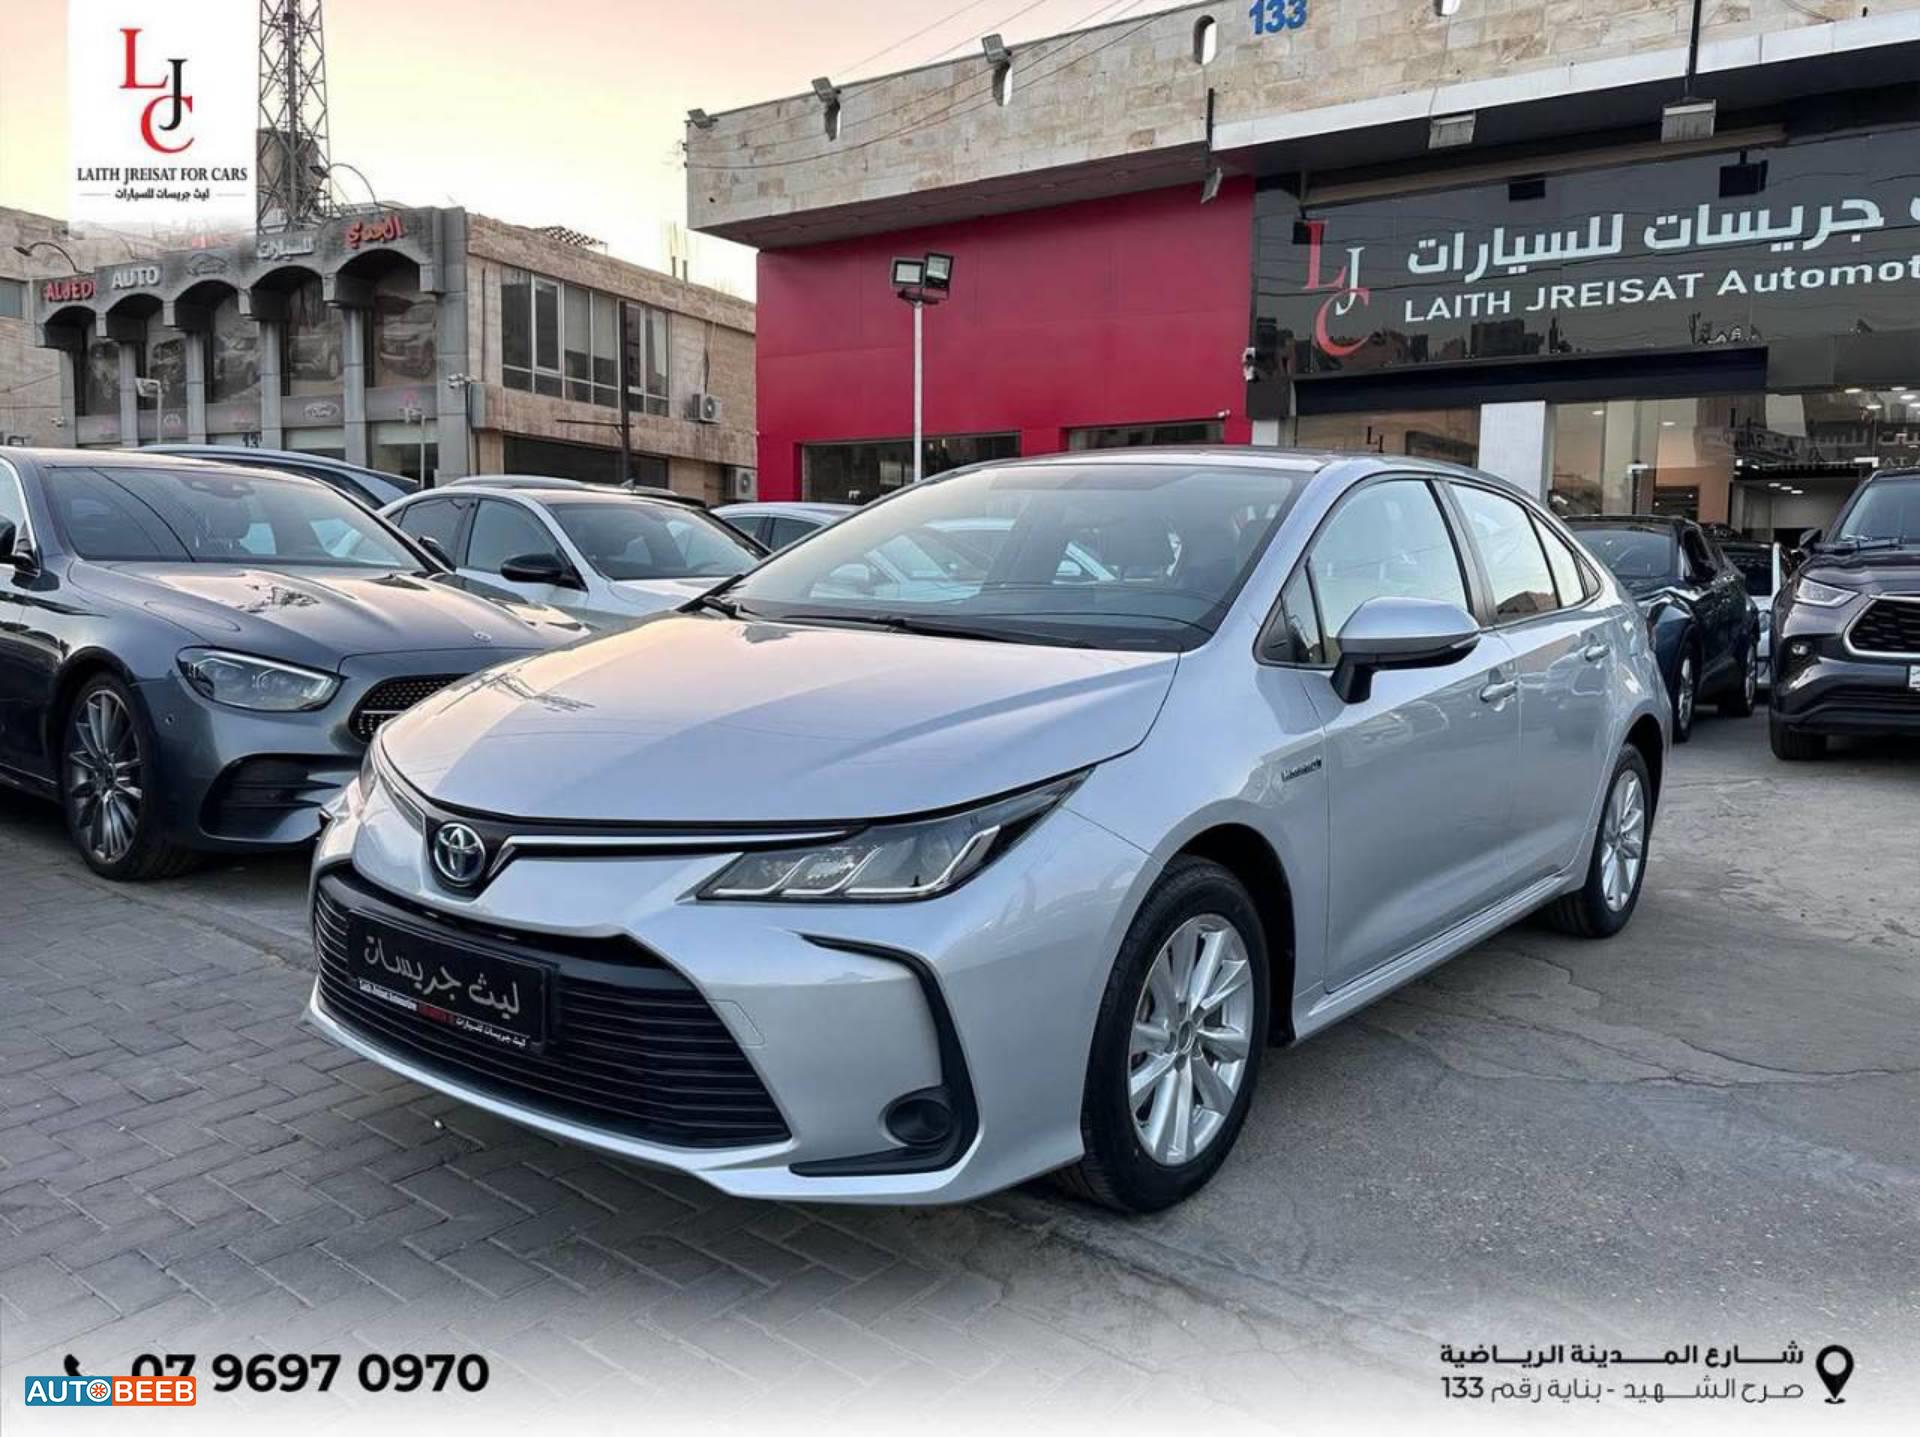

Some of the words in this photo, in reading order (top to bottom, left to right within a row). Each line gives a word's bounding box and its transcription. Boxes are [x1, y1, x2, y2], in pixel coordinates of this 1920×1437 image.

[1249, 0, 1307, 35] 133
[1408, 213, 1623, 283] للسيارات
[1644, 199, 1884, 252] جريسات
[111, 266, 160, 290] AUTO
[1405, 290, 1510, 322] LAITH
[1525, 272, 1704, 312] JREISAT
[1717, 255, 1920, 295] Automot
[469, 973, 520, 1020] ليث
